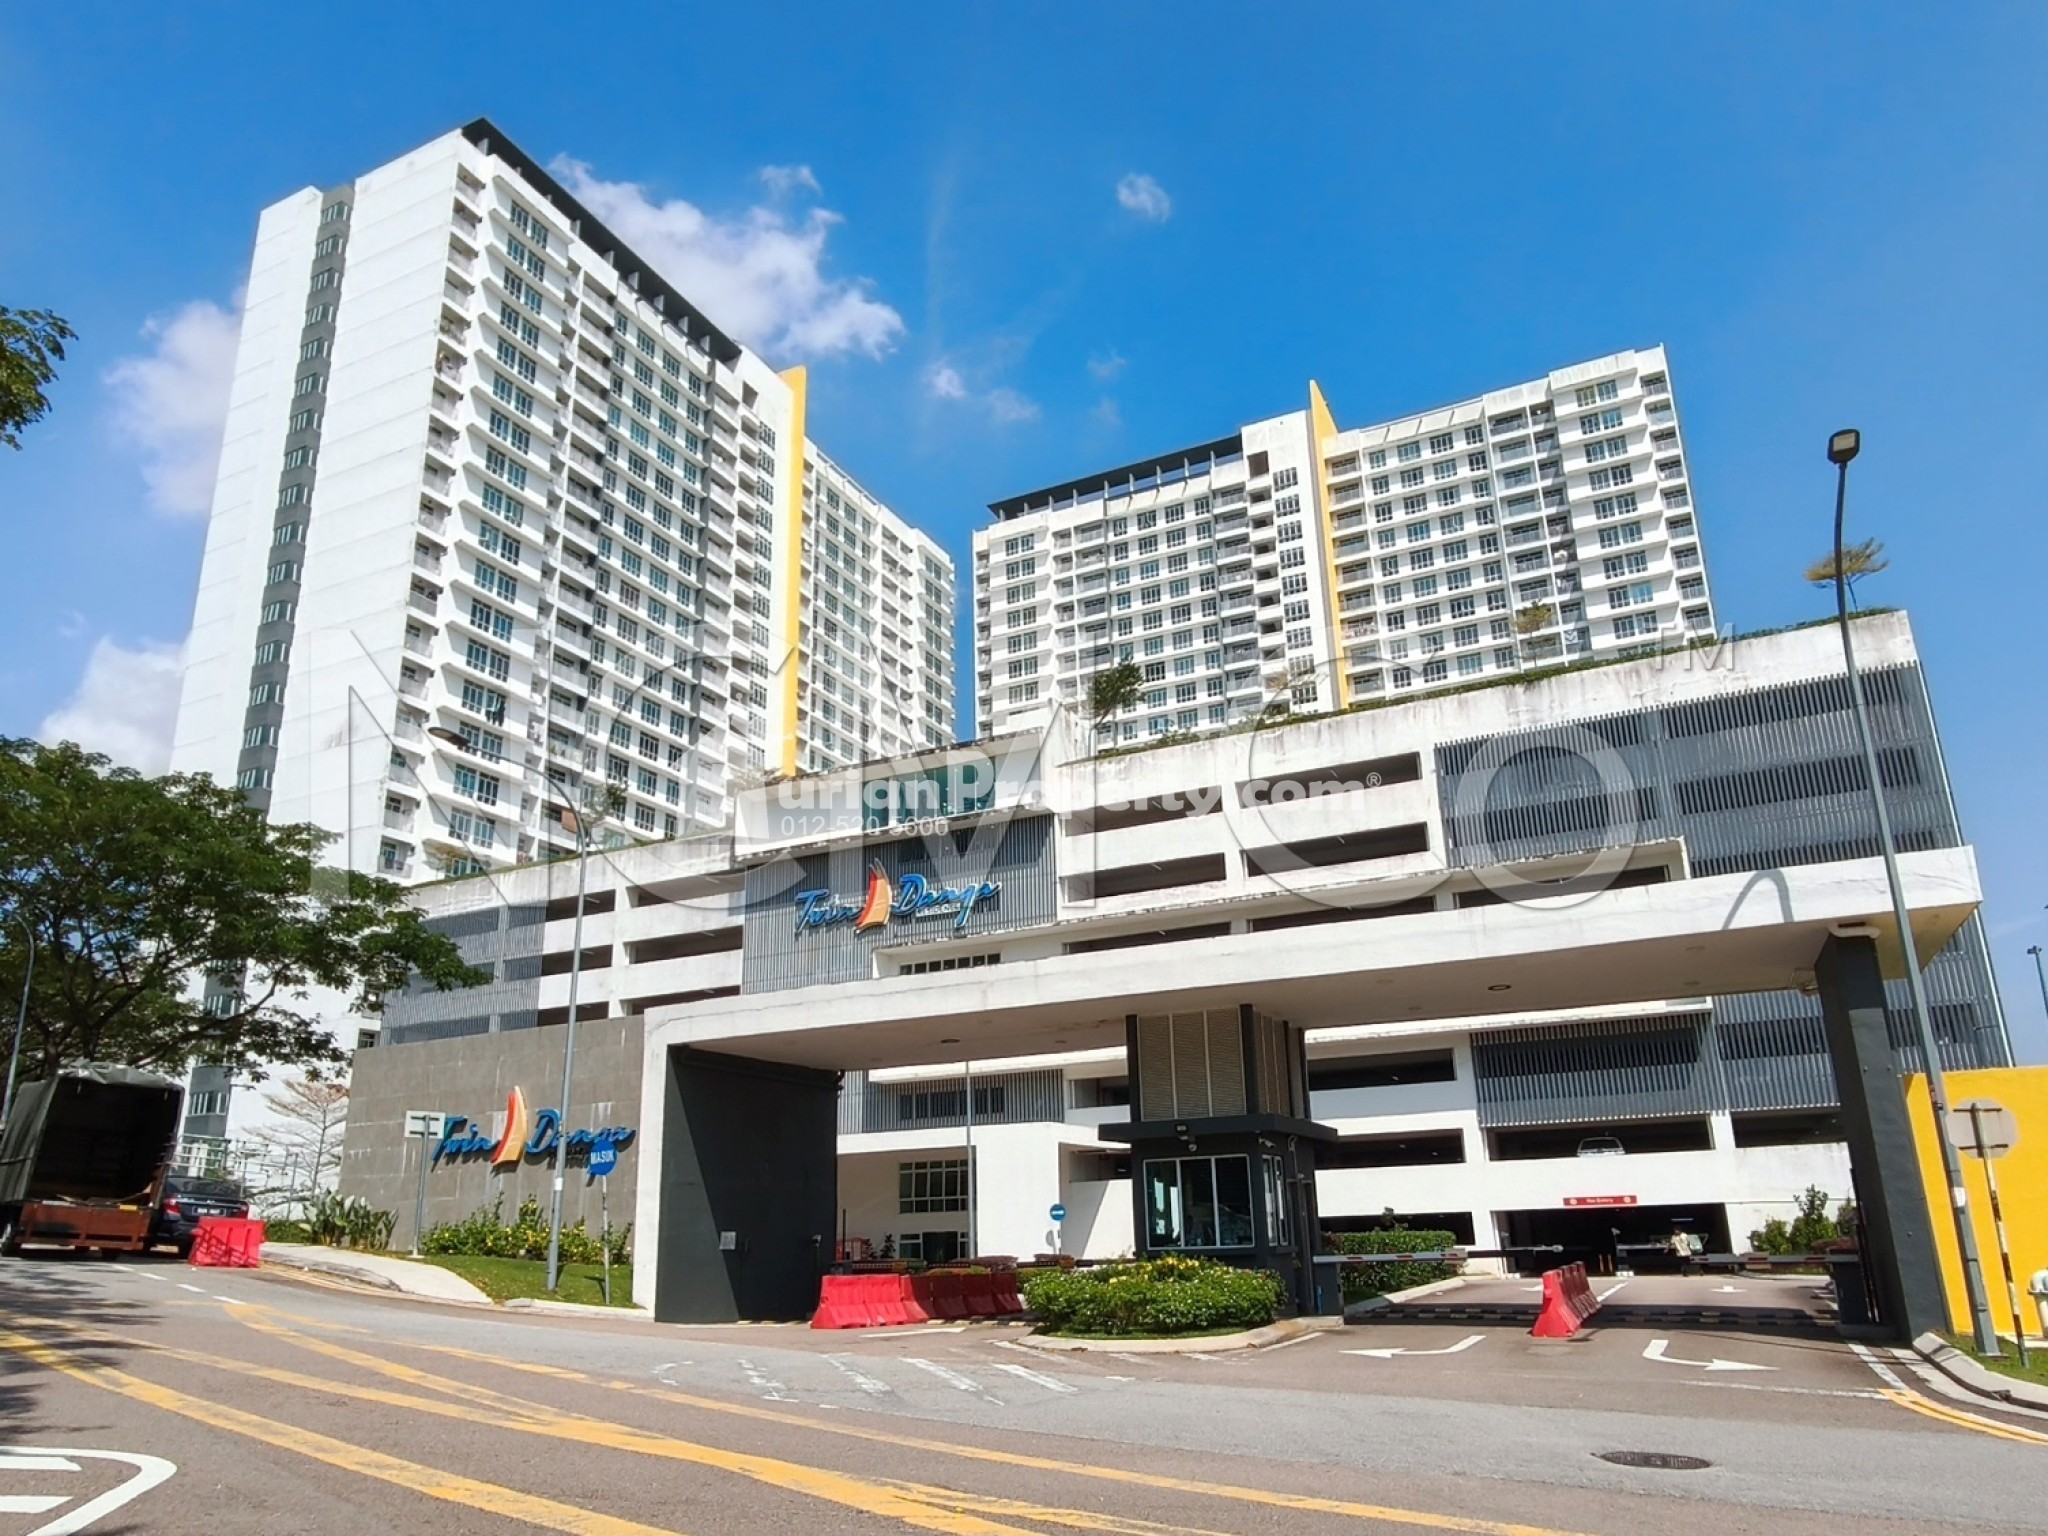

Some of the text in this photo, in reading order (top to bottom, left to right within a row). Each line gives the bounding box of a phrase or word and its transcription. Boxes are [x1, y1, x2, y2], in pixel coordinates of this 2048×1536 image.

[795, 873, 1003, 933] Twin Danga
[432, 1115, 498, 1161] Twin
[590, 1149, 615, 1165] MASUK
